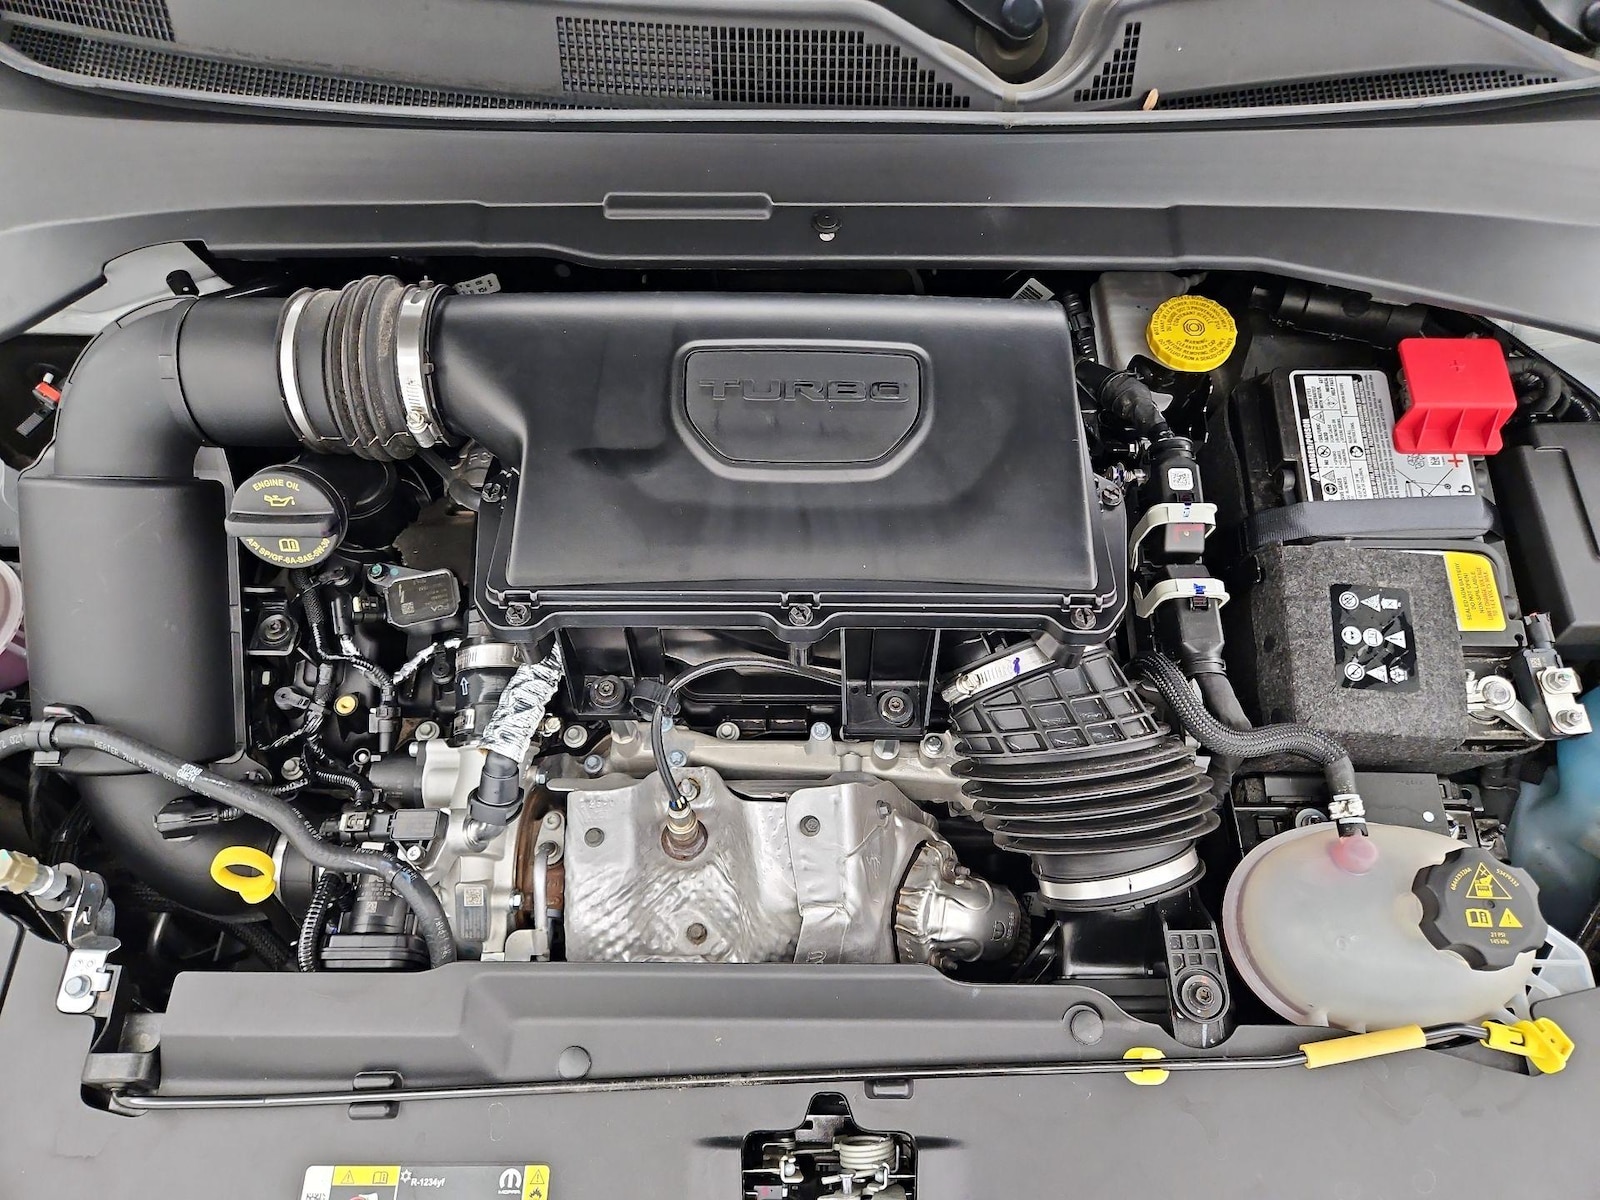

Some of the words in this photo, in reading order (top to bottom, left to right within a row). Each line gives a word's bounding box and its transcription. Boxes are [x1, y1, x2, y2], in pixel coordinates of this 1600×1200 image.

[698, 379, 910, 402] TURBO
[1301, 417, 1318, 473] DANGER/POISON
[252, 479, 284, 492] ENGINE
[286, 481, 300, 492] OIL
[246, 538, 261, 551] API
[410, 1177, 446, 1188] R-1234yf
